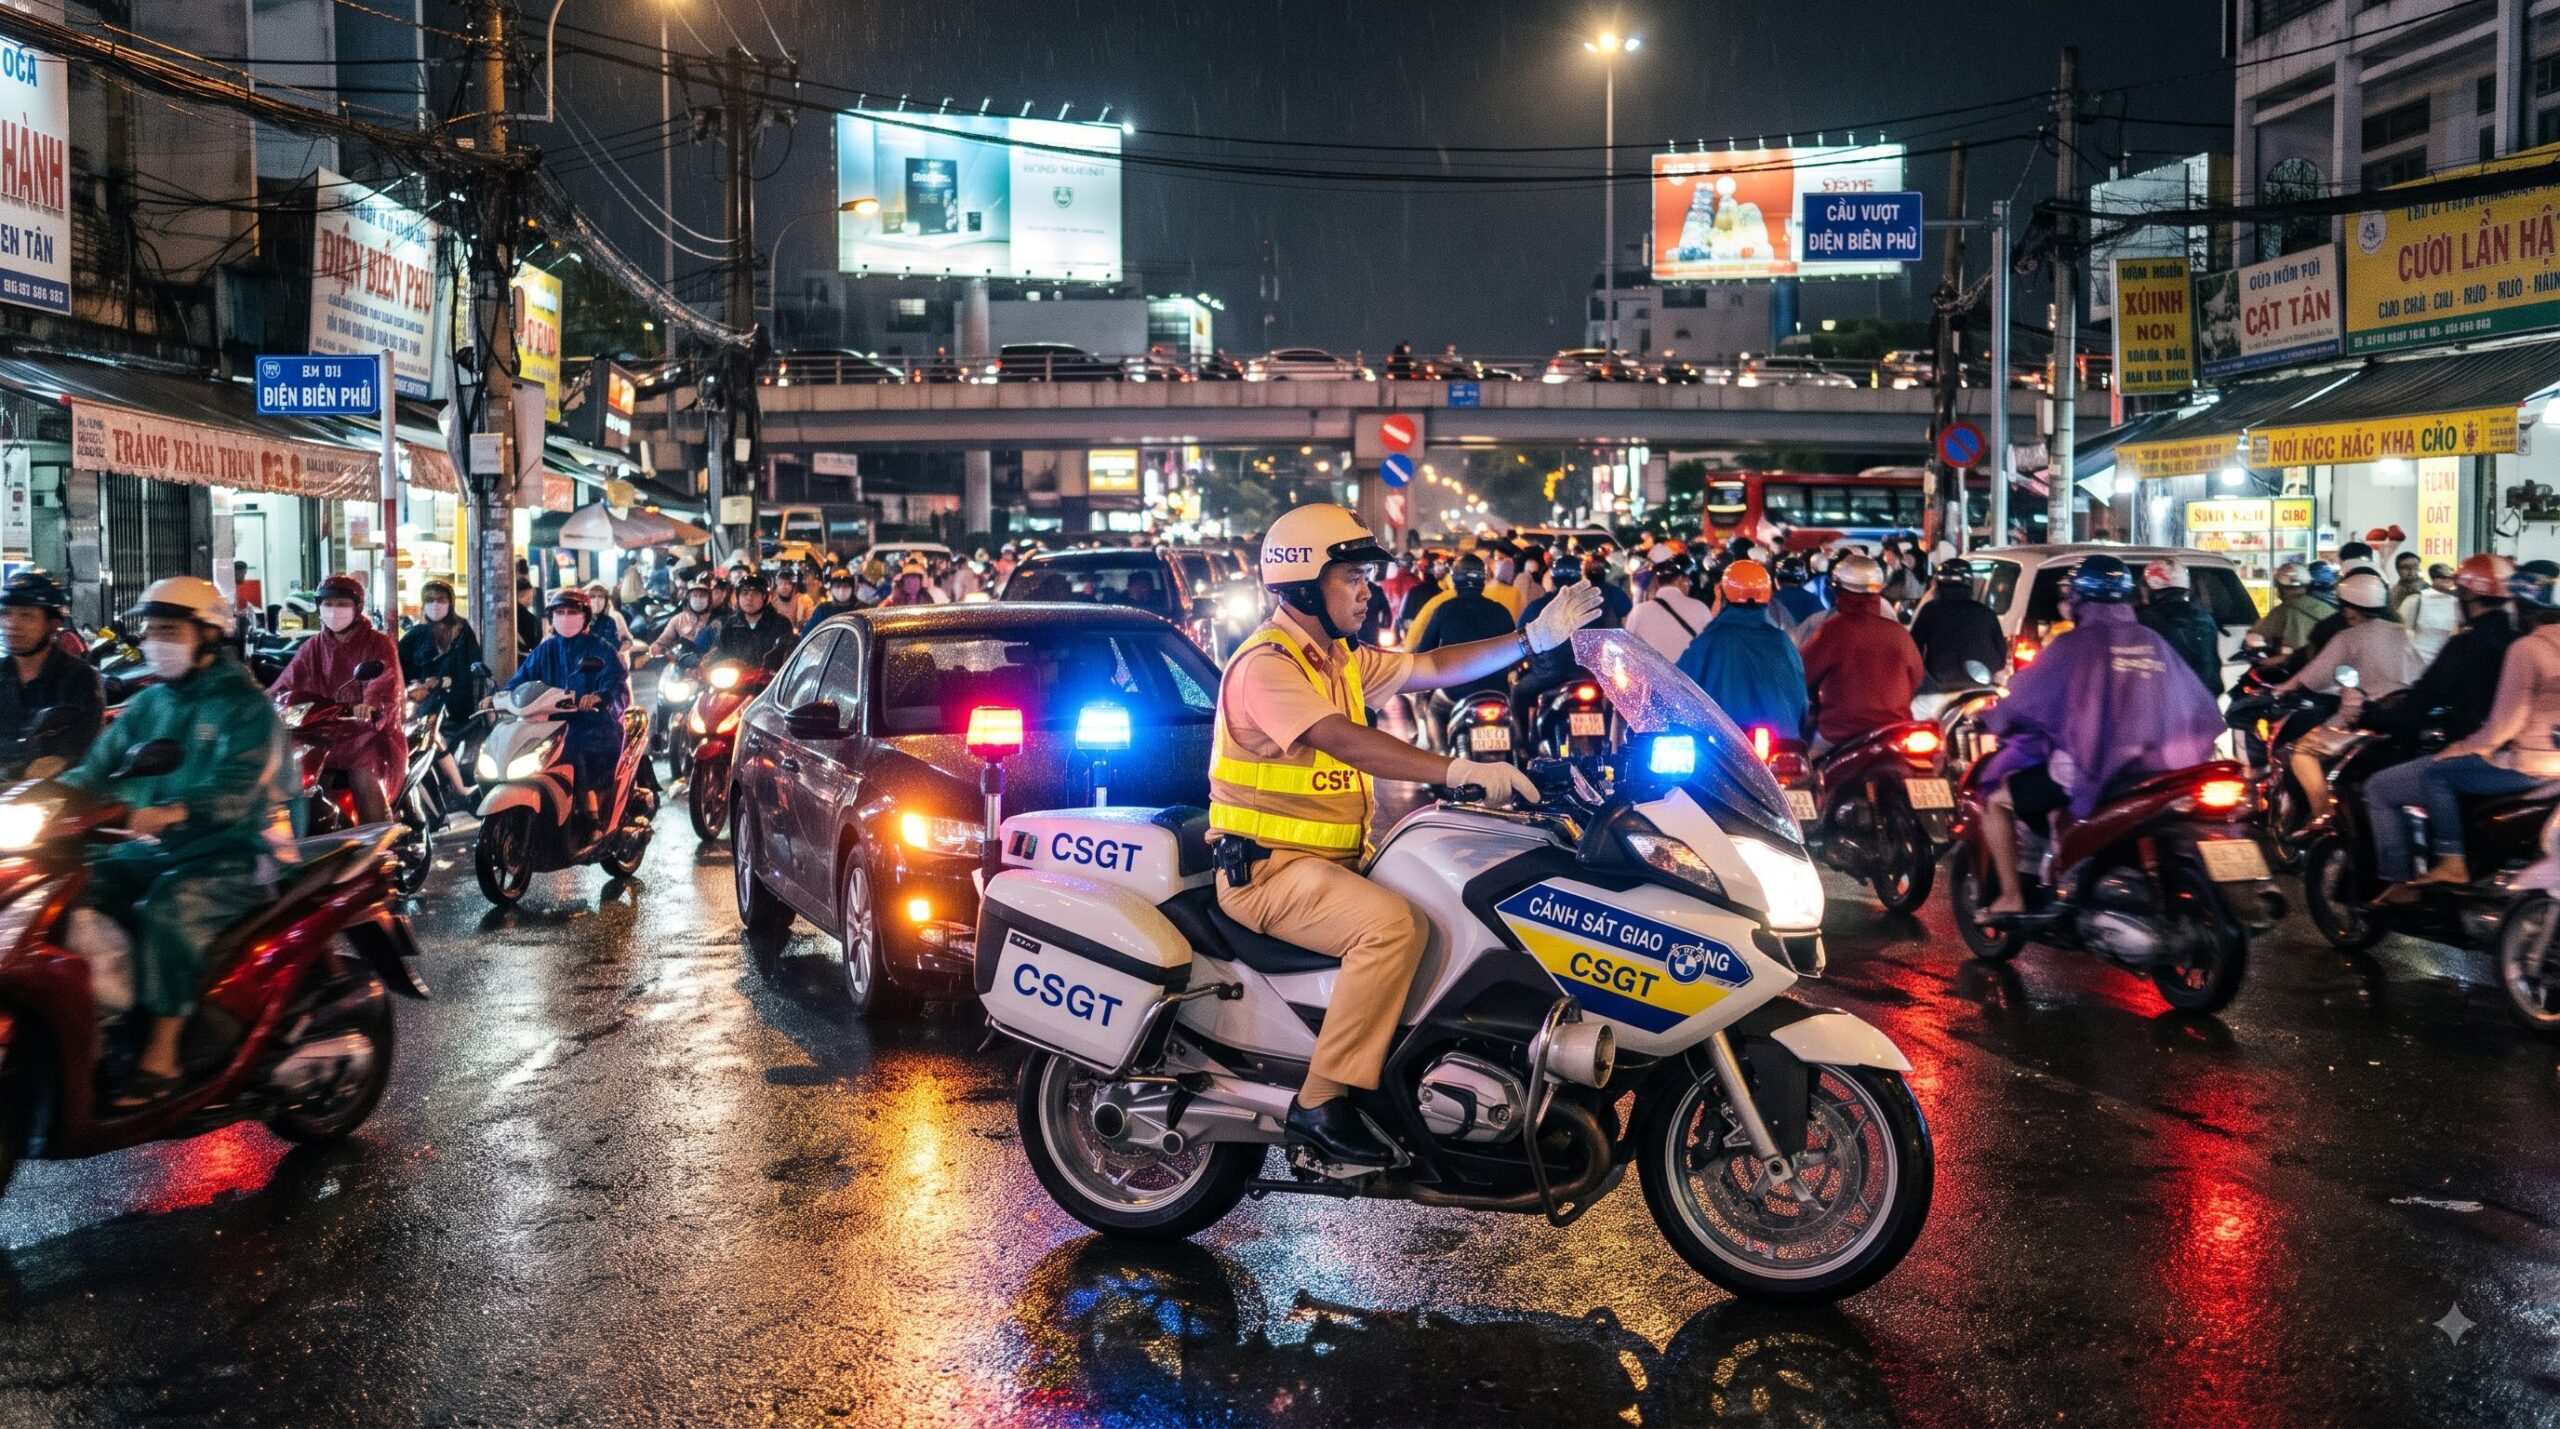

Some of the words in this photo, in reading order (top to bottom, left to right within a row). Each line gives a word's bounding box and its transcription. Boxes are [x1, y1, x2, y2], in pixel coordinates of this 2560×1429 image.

[1861, 204, 1900, 224] VƯỢT
[24, 226, 54, 264] TÂN
[1808, 229, 1843, 254] ĐIỆN
[1848, 228, 1881, 250] BIÊN
[2288, 286, 2331, 326] TÂN
[264, 382, 297, 410] ĐIỆN
[302, 383, 336, 407] BIÊN
[1051, 832, 1143, 872] CSGT
[1529, 893, 1579, 926] CẢNH
[1581, 911, 1618, 937] SÁT
[1620, 924, 1663, 951] GIAO
[1570, 952, 1660, 997] CSGT
[1013, 963, 1123, 1027] CSGT
